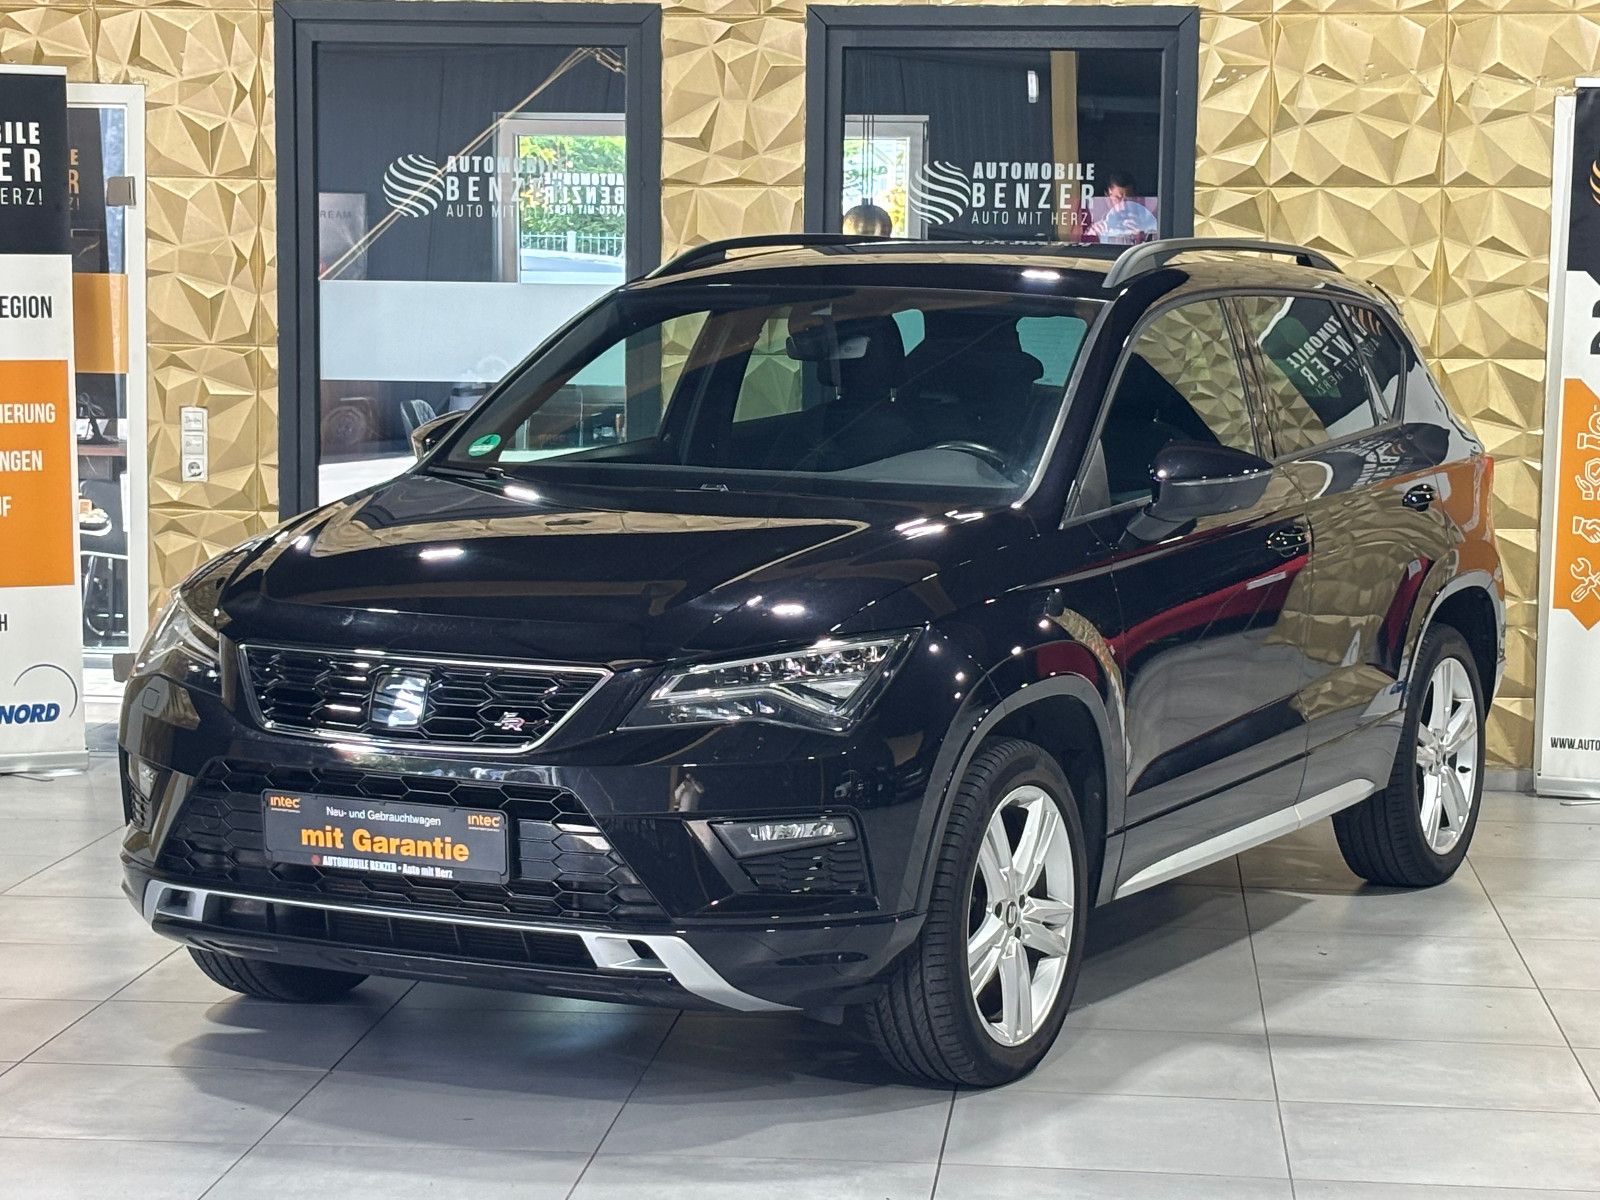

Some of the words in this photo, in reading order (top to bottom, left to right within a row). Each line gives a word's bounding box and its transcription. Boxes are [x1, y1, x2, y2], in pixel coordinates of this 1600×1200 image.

[0, 121, 40, 145] ILE
[0, 147, 42, 183] ER
[972, 161, 1095, 181] AUTOMOBILE
[446, 175, 524, 202] BENZ
[972, 182, 1095, 210] BENZER
[446, 204, 484, 218] AUTO
[971, 210, 1010, 225] AUTO
[1017, 211, 1043, 225] MIT
[0, 295, 53, 319] EGION
[326, 806, 347, 818] Neu-
[349, 810, 366, 819] und
[367, 810, 441, 828] Gebrauchtwagen
[301, 825, 345, 850] mit
[352, 828, 470, 862] Garantie
[420, 866, 436, 878] mit
